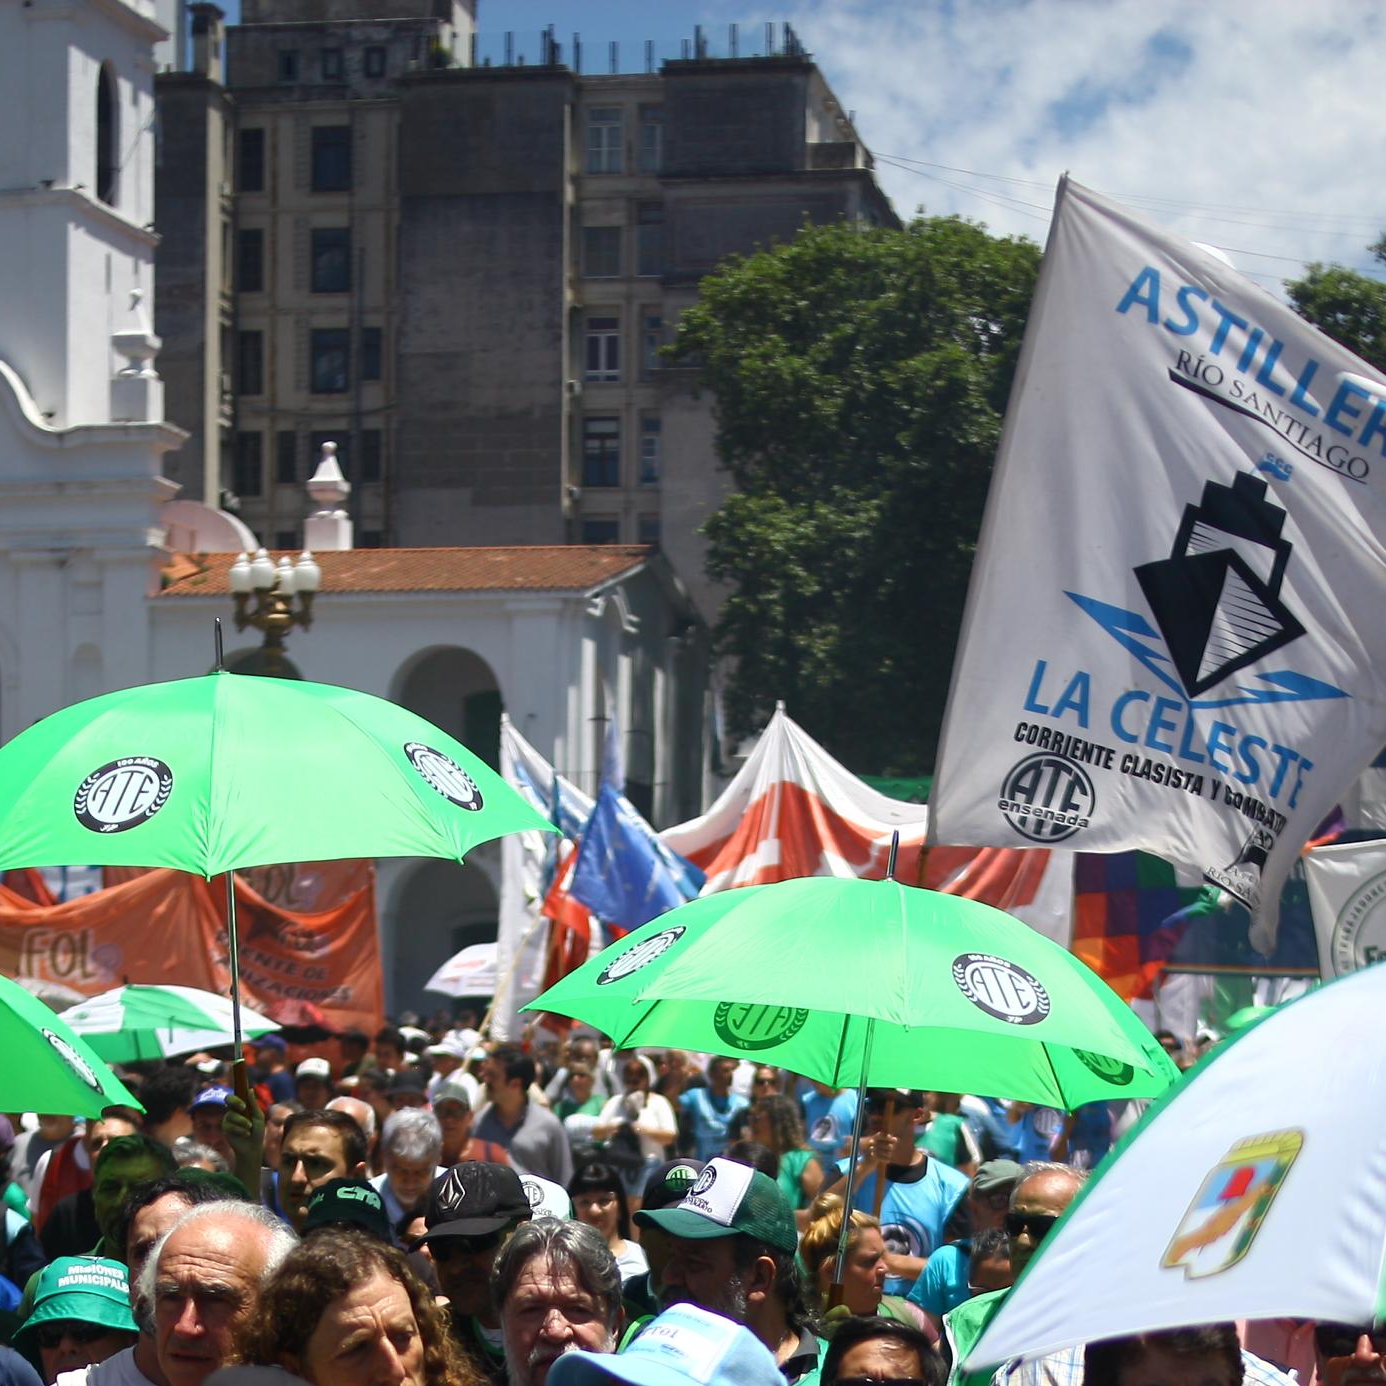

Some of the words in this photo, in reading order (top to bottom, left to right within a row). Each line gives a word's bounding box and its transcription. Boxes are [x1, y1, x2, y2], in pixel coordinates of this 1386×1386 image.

[1175, 349, 1224, 388] RÍO
[1228, 378, 1370, 484] SANTIAGO
[1024, 660, 1092, 730] LA
[1014, 722, 1116, 770] CORRIENTE
[1120, 754, 1204, 796] CLASISTA
[1210, 778, 1225, 801] Y
[92, 770, 154, 816] ATE
[999, 797, 1090, 829] ensenada
[1009, 759, 1088, 836] ATE
[24, 926, 96, 981] FOL
[969, 966, 1031, 1009] ATE
[336, 1186, 381, 1210] CTA
